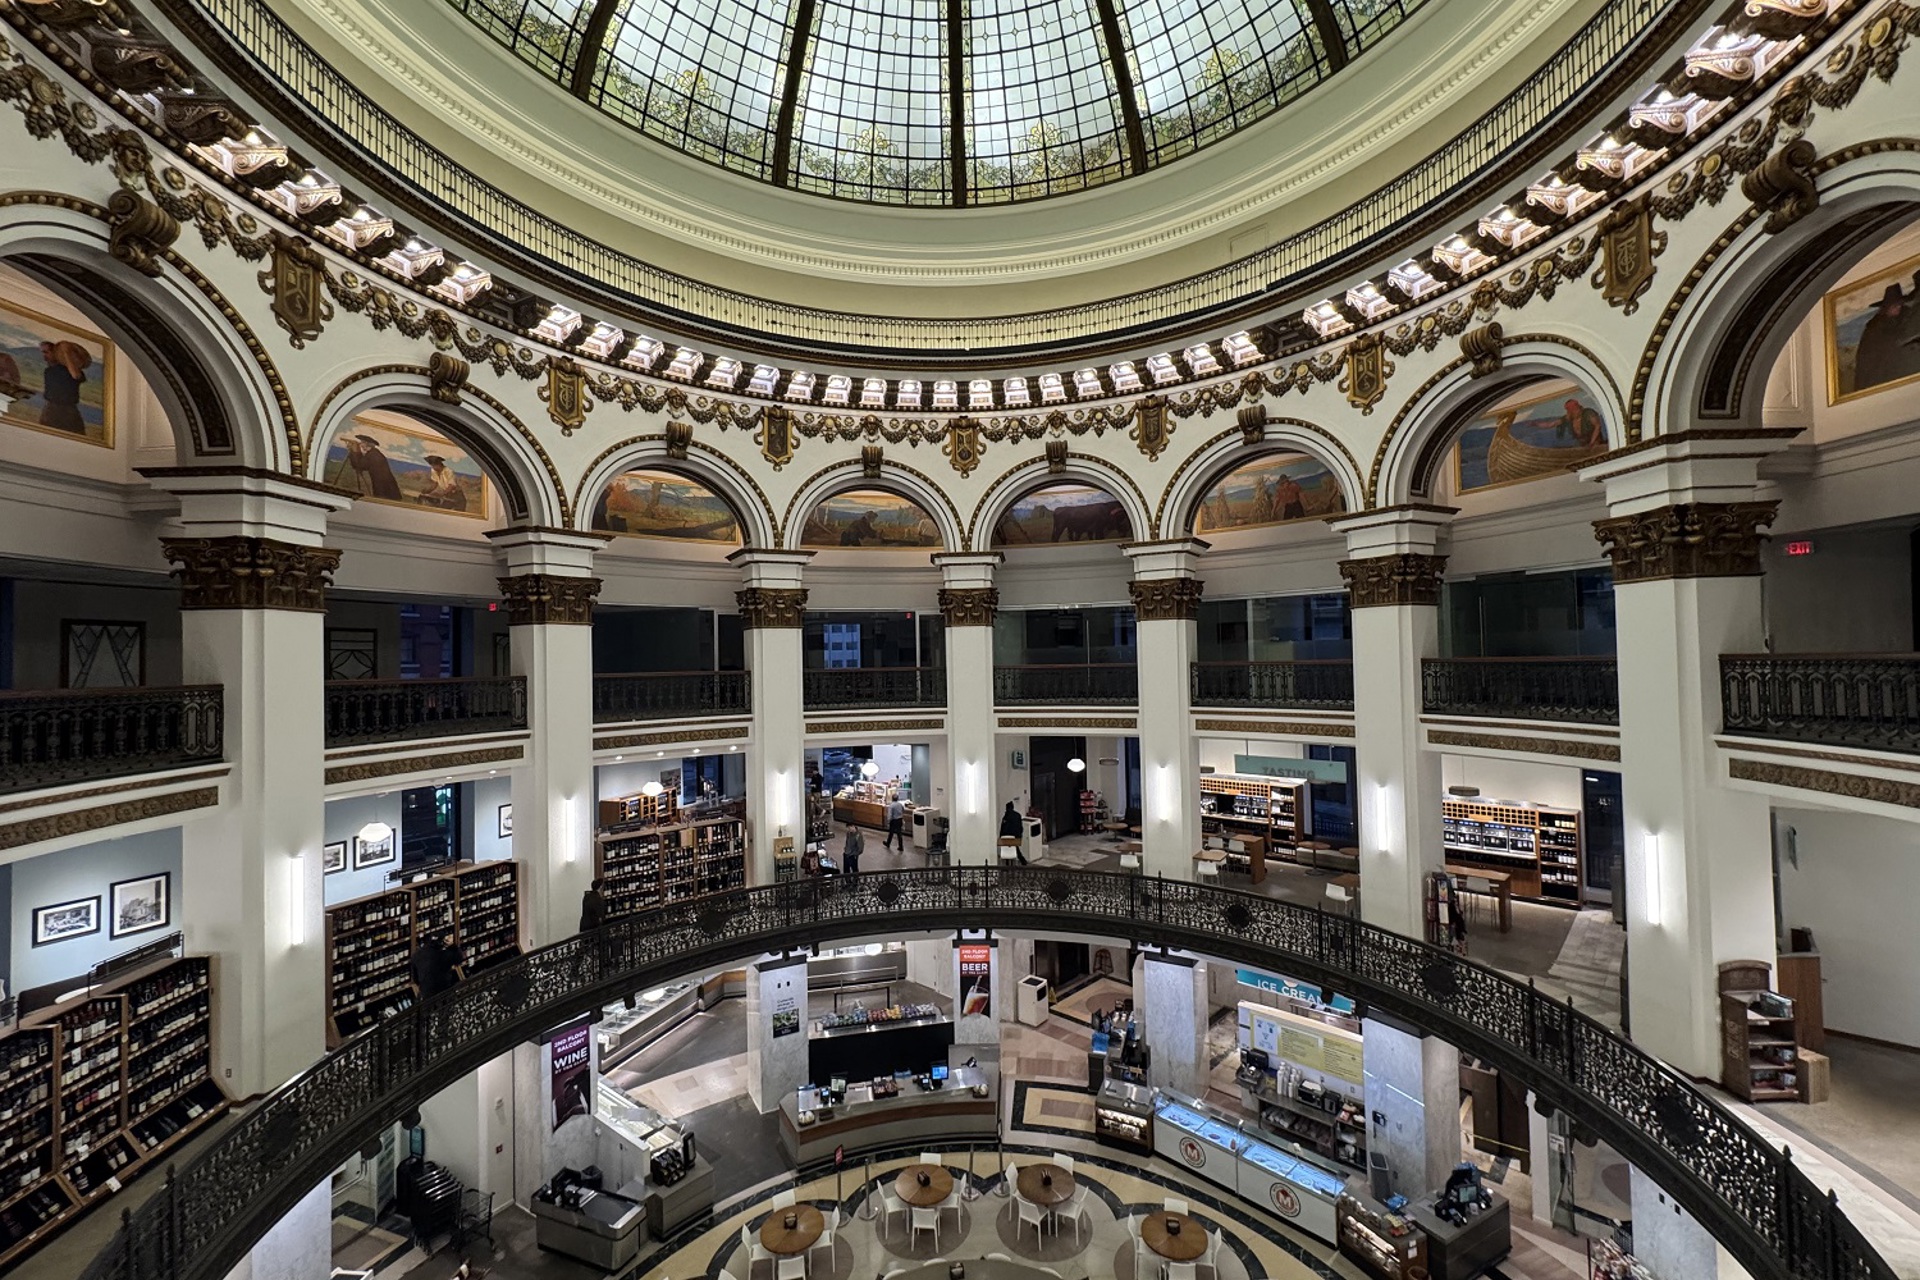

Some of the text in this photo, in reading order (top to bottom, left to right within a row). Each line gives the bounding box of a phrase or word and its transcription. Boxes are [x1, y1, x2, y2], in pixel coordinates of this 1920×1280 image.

[1262, 767, 1316, 779] TASTING
[962, 963, 988, 971] BEER
[1257, 979, 1277, 992] ICE
[554, 1046, 587, 1069] WINE
